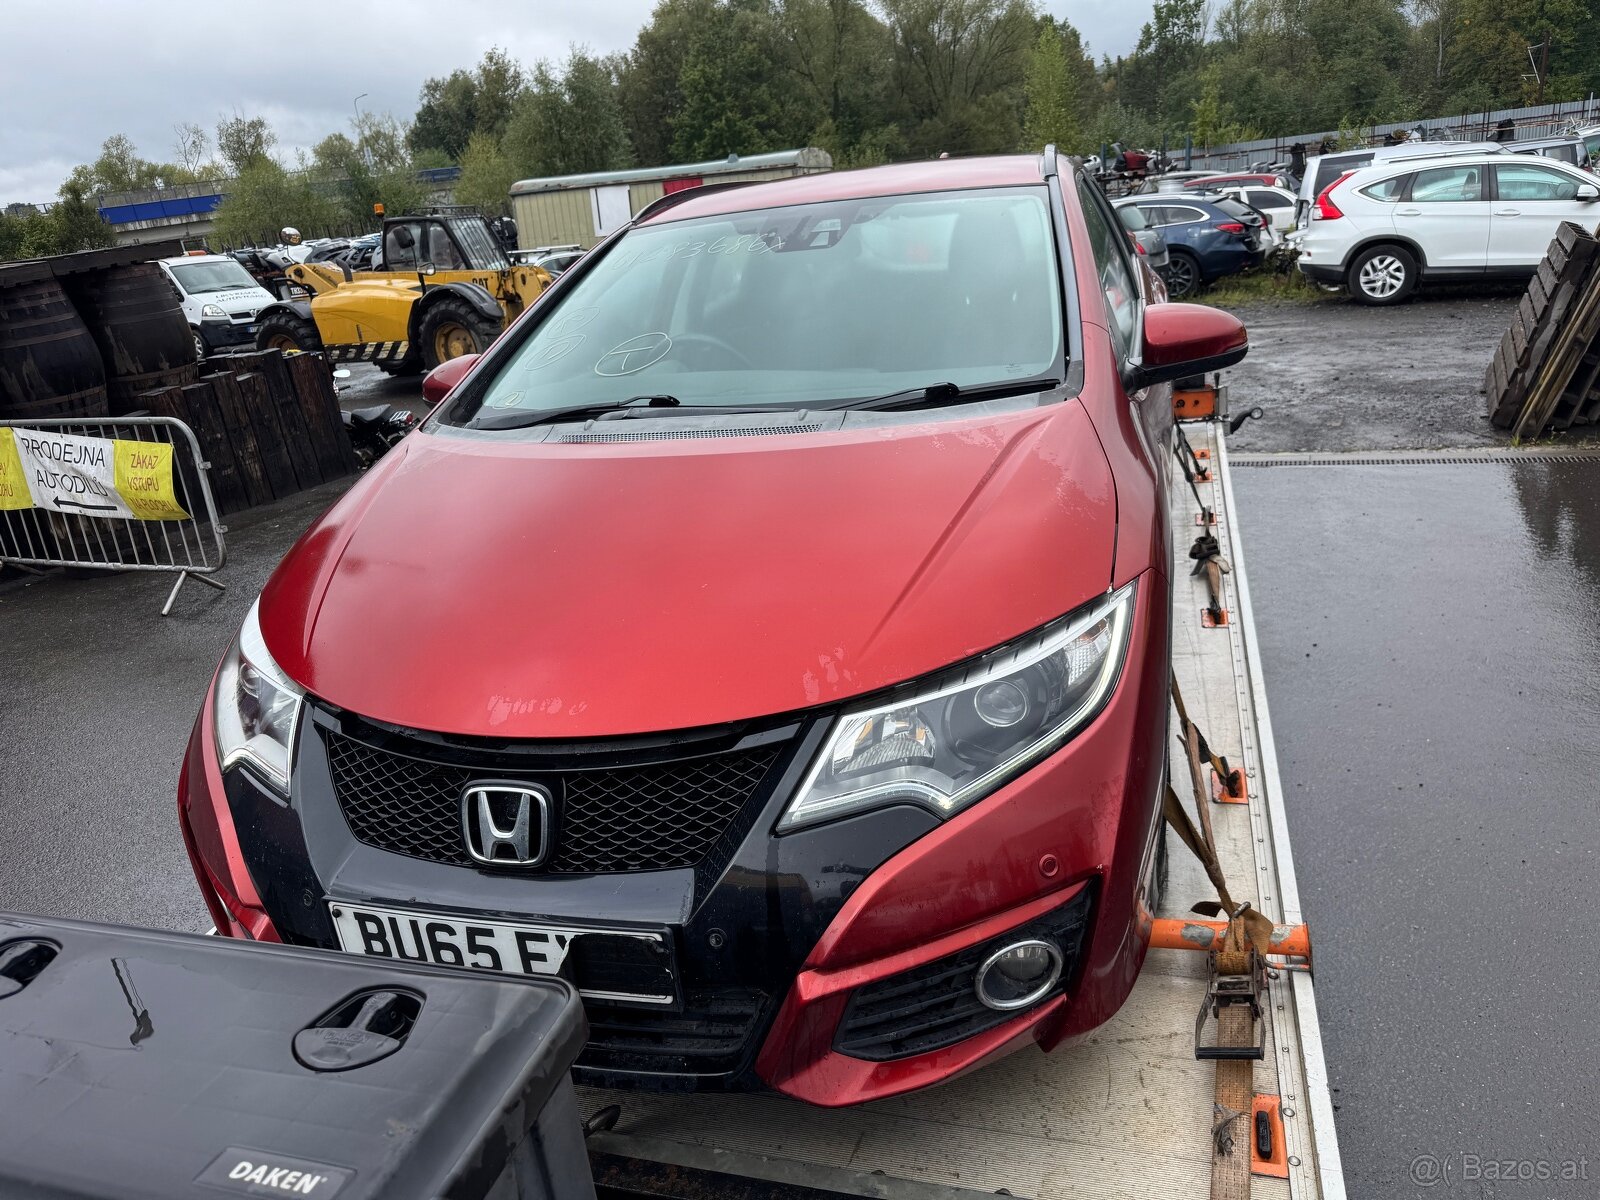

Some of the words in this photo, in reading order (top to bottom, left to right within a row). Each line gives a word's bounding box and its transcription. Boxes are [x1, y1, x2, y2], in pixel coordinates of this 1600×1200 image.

[20, 437, 106, 468] PRODEJNA
[130, 451, 159, 470] ZÁKAZ
[127, 476, 160, 492] VSTUPU
[353, 911, 503, 971] BU65
[514, 931, 568, 975] E
[228, 1161, 321, 1194] DAKEN
